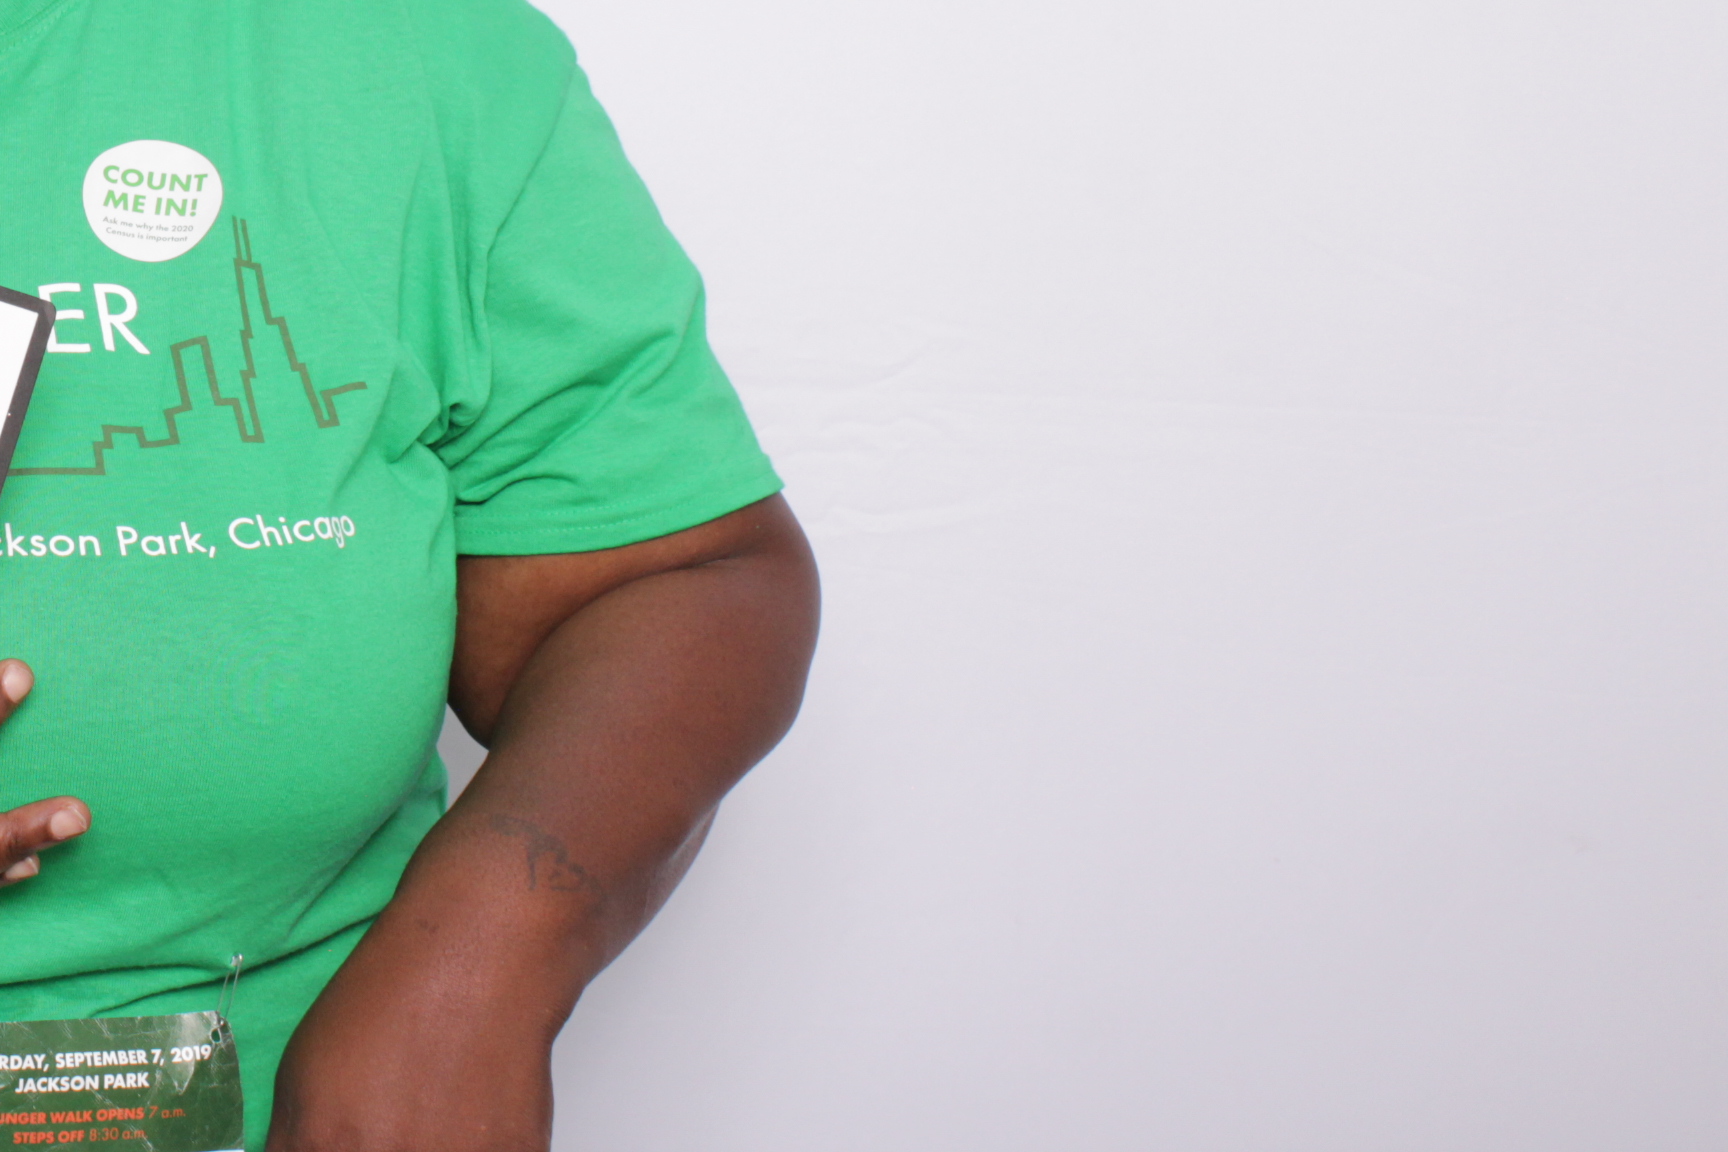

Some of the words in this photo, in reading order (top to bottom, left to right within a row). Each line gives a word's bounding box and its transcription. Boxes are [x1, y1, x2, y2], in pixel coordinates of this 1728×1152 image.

[103, 164, 209, 192] COUNT
[102, 189, 147, 214] ME
[154, 197, 198, 217] IN!
[102, 216, 118, 225] Ask
[136, 223, 154, 232] why
[156, 224, 169, 232] the
[171, 225, 194, 233] 2020
[106, 226, 135, 239] Census
[137, 232, 144, 240] is
[146, 233, 188, 243] important
[115, 521, 216, 558] Park,
[228, 514, 356, 549] Chicago
[55, 1048, 148, 1069] SEPTEMBER
[151, 1048, 165, 1067] 7,
[170, 1044, 213, 1063] 2019
[14, 1074, 100, 1094] JACKSON
[104, 1072, 150, 1090] PARK
[49, 1109, 93, 1123] WALK
[95, 1107, 145, 1122] OPENS
[147, 1106, 159, 1119] 7
[161, 1108, 186, 1119] a.m.
[13, 1131, 55, 1145] STEPS
[57, 1130, 85, 1143] OFF
[89, 1128, 119, 1142] 8:30
